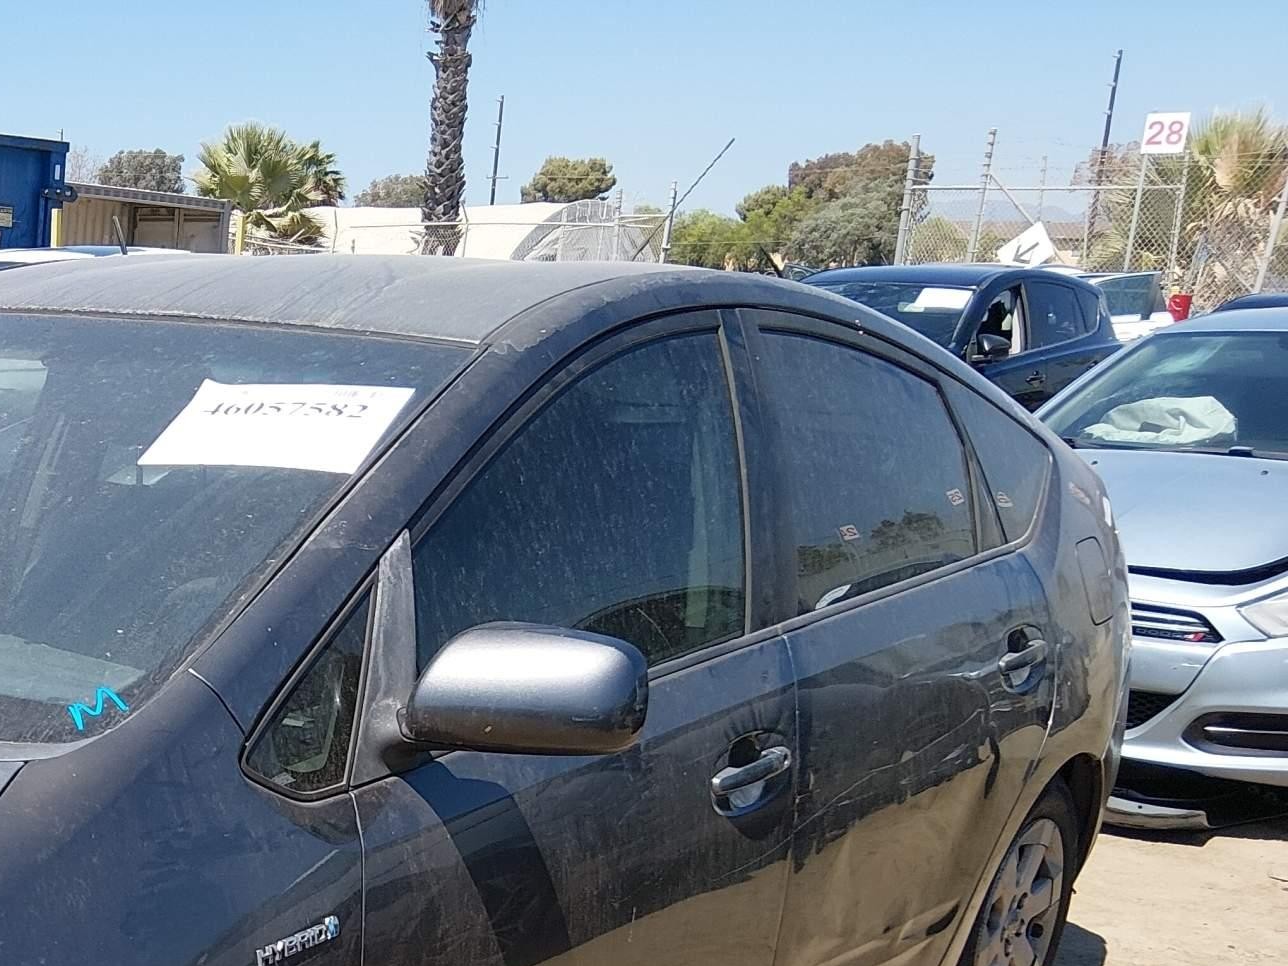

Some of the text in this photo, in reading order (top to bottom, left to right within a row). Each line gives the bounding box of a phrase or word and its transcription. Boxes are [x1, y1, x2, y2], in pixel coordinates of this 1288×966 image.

[1144, 120, 1184, 146] 28
[203, 402, 369, 418] 46057582
[67, 687, 129, 732] M
